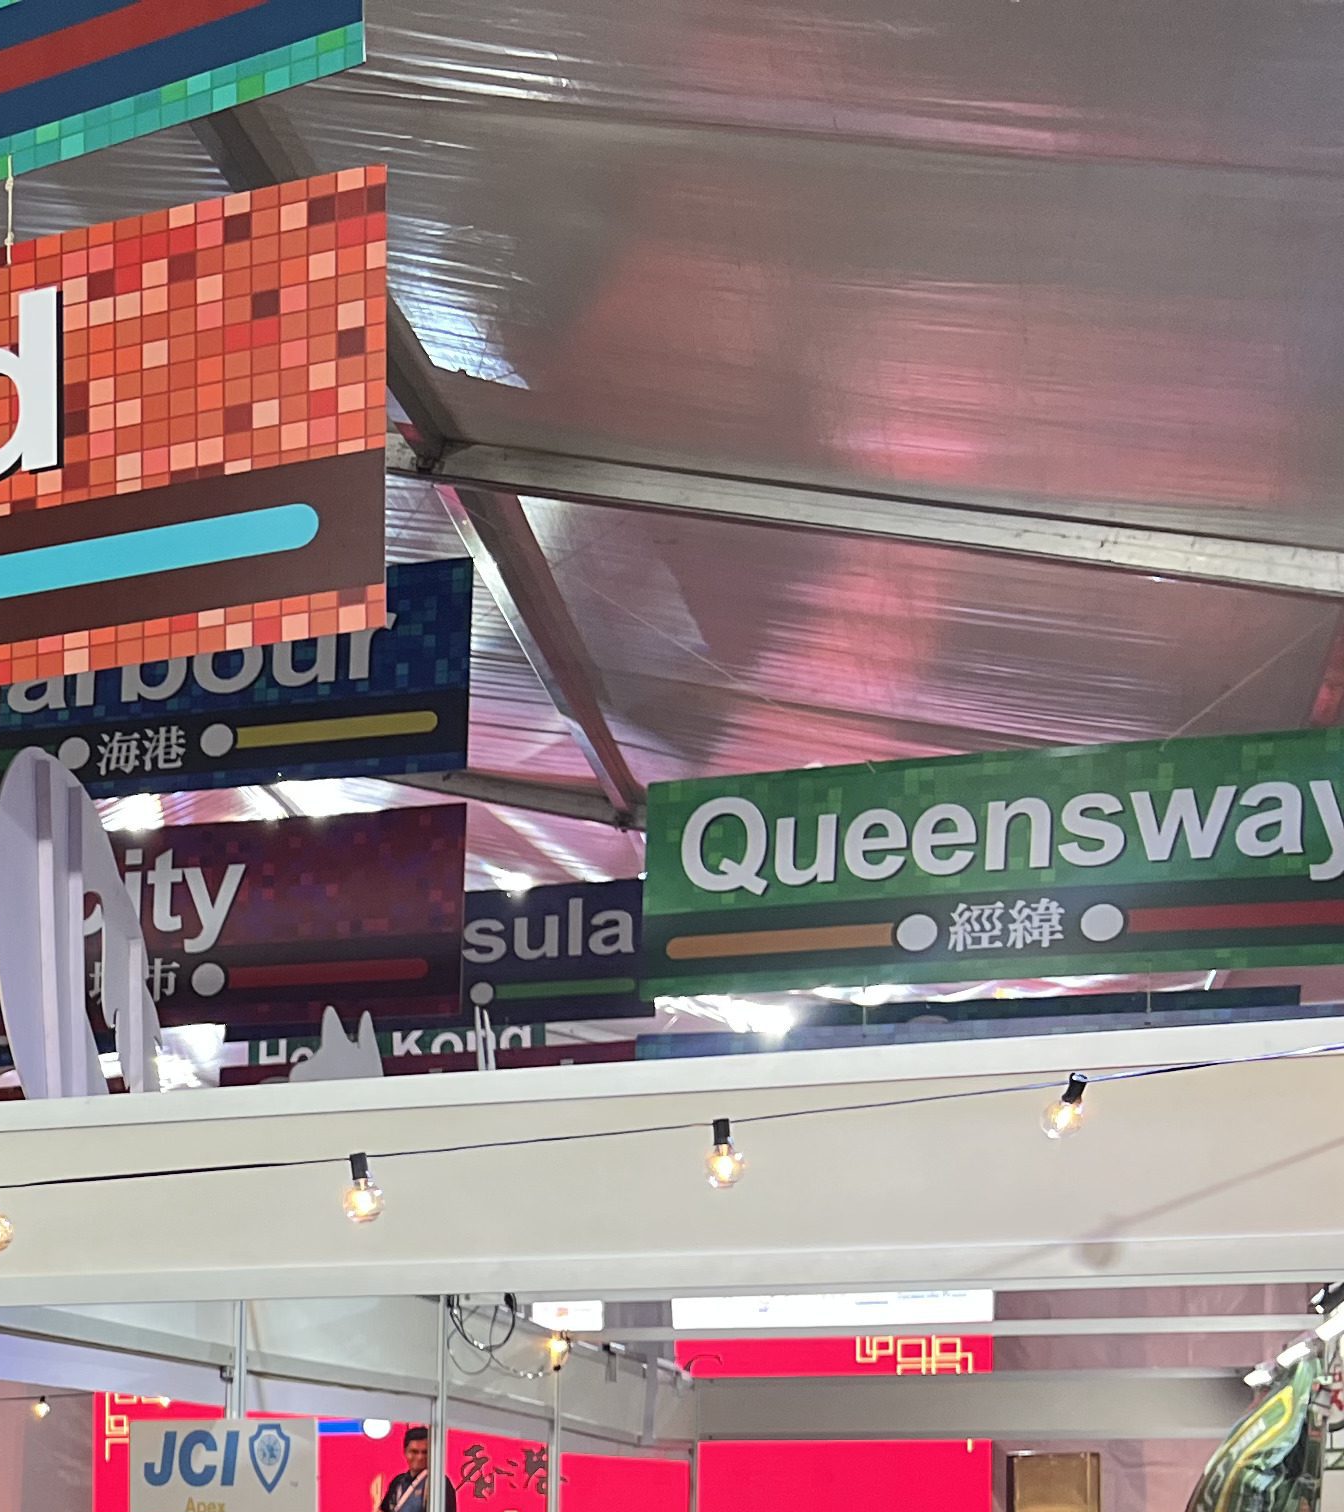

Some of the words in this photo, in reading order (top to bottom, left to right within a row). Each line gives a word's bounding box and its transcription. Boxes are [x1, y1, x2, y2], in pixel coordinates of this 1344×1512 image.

[97, 726, 186, 776] 海港
[83, 847, 246, 953] ity
[947, 898, 1067, 953] 經緯
[142, 1429, 240, 1487] JCI
